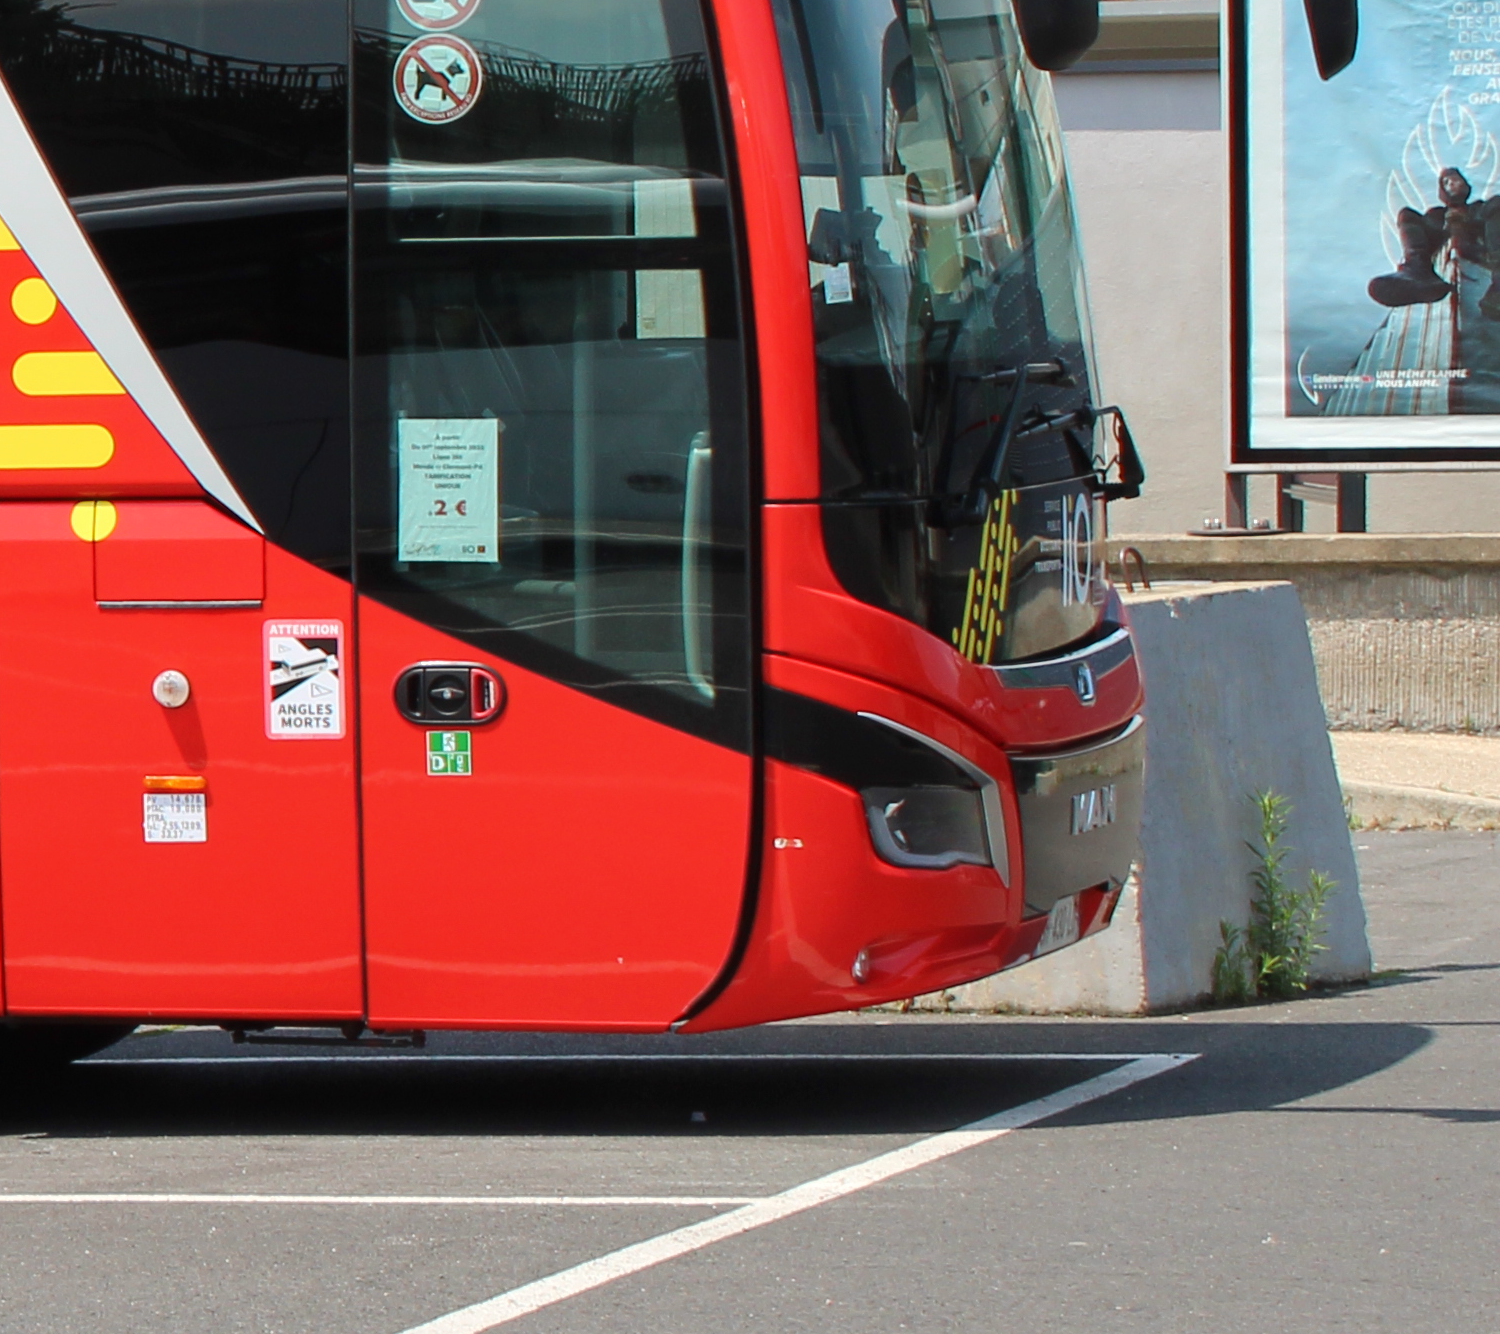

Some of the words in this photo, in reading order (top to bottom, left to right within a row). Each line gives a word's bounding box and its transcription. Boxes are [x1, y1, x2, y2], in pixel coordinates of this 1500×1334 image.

[1453, 2, 1479, 14] ON
[1375, 379, 1403, 389] NOUS
[434, 499, 448, 516] 2
[454, 499, 467, 516] €
[269, 624, 339, 635] ATTENTION
[277, 703, 333, 716] ANGLES
[281, 716, 331, 729] MORTS
[1071, 784, 1117, 836] MAN
